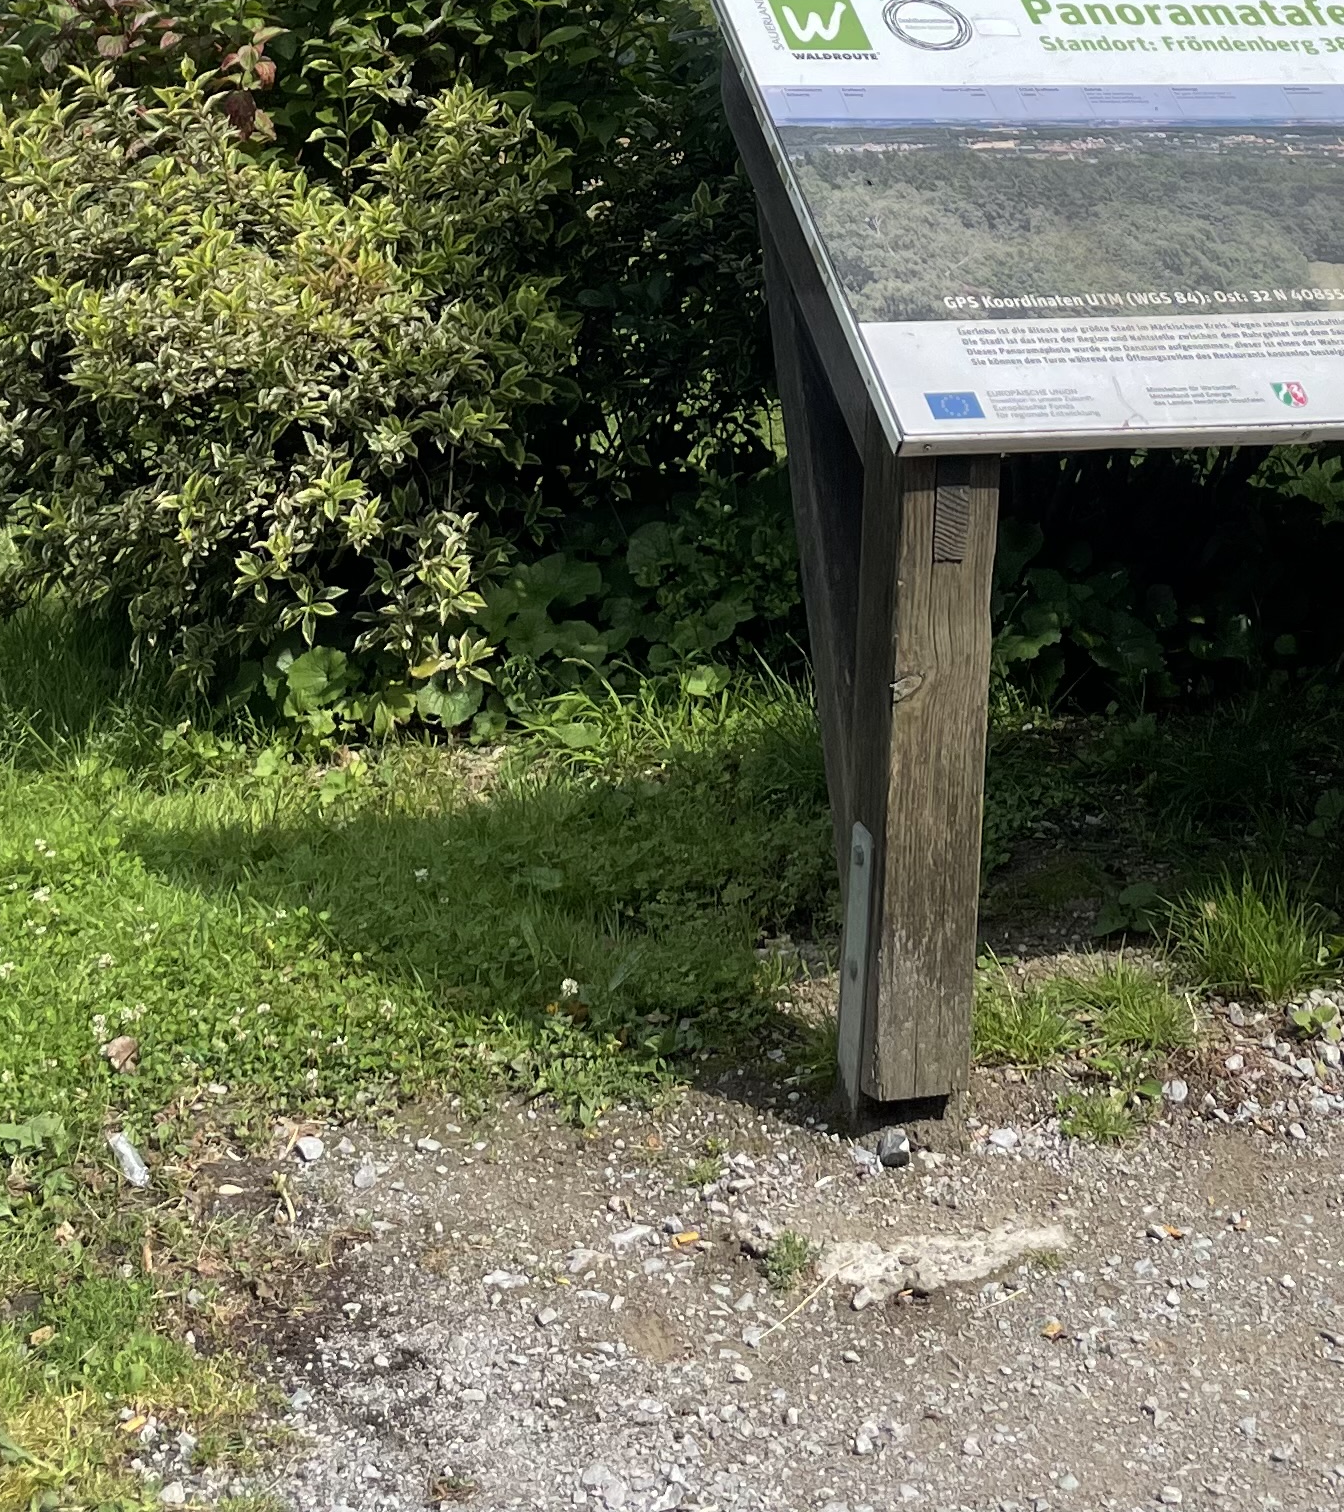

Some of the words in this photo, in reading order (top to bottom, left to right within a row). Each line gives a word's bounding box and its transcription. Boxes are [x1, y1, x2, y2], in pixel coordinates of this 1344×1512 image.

[1039, 35, 1158, 52] Standort:
[1161, 36, 1320, 56] Fröndenberg
[791, 52, 879, 61] WALDROUTE
[943, 295, 979, 309] GPS
[981, 294, 1085, 308] Koordinaten
[1084, 292, 1125, 306] UTM
[1126, 291, 1172, 306] (WGS
[1173, 290, 1211, 305] 84):
[1213, 289, 1248, 303] Ost:
[1249, 290, 1272, 302] 32
[1272, 289, 1288, 301] N
[1110, 323, 1135, 331] Stadt
[979, 337, 1004, 345] Stadt
